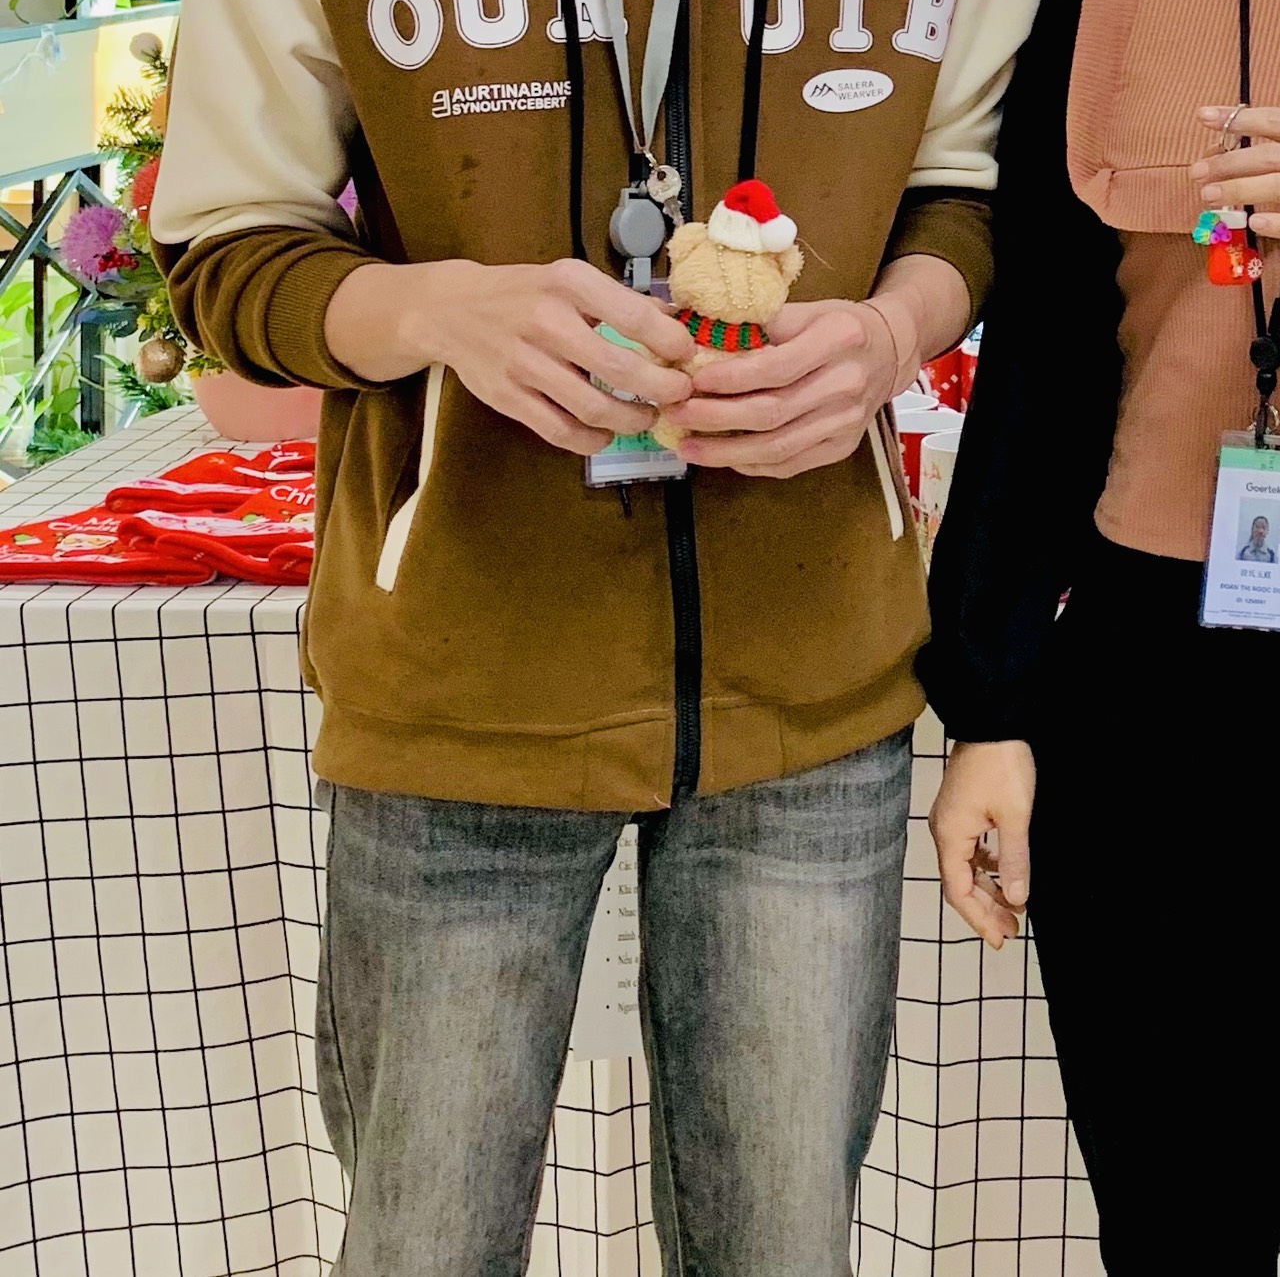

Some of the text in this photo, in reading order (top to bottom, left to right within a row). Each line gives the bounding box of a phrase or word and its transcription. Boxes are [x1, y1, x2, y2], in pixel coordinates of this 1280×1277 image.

[837, 80, 874, 91] SALERA
[838, 88, 884, 100] WEARVER
[451, 96, 568, 116] SYNOUTYCEBERT
